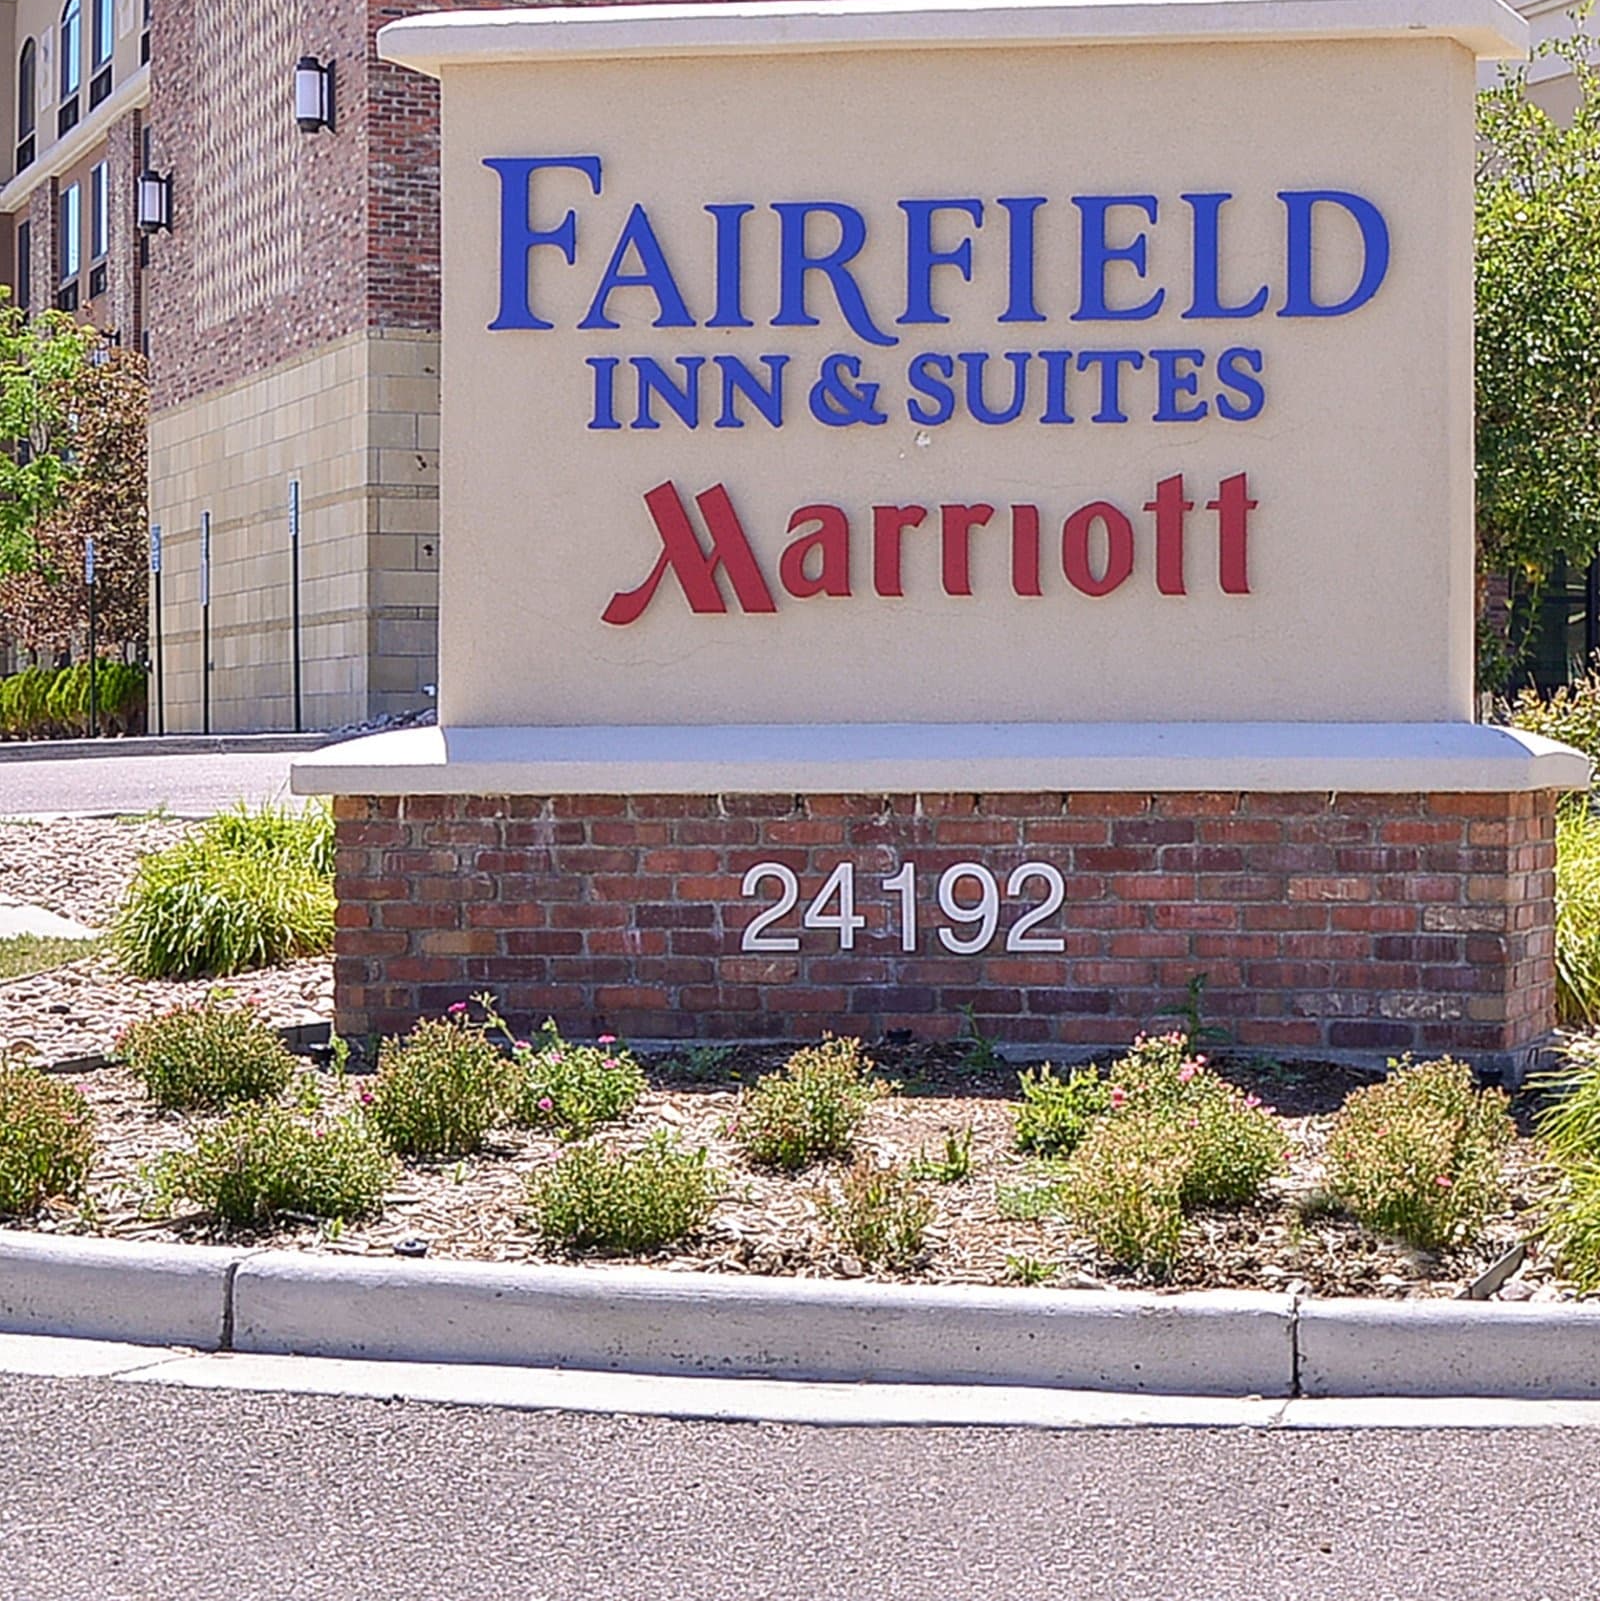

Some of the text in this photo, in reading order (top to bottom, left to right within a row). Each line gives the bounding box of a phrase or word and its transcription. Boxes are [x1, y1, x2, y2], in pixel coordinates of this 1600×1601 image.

[482, 154, 1391, 346] FAIRFIELD
[586, 346, 1266, 430] INN & SUITES
[602, 473, 1258, 625] Marriott
[741, 861, 1065, 954] 24192
